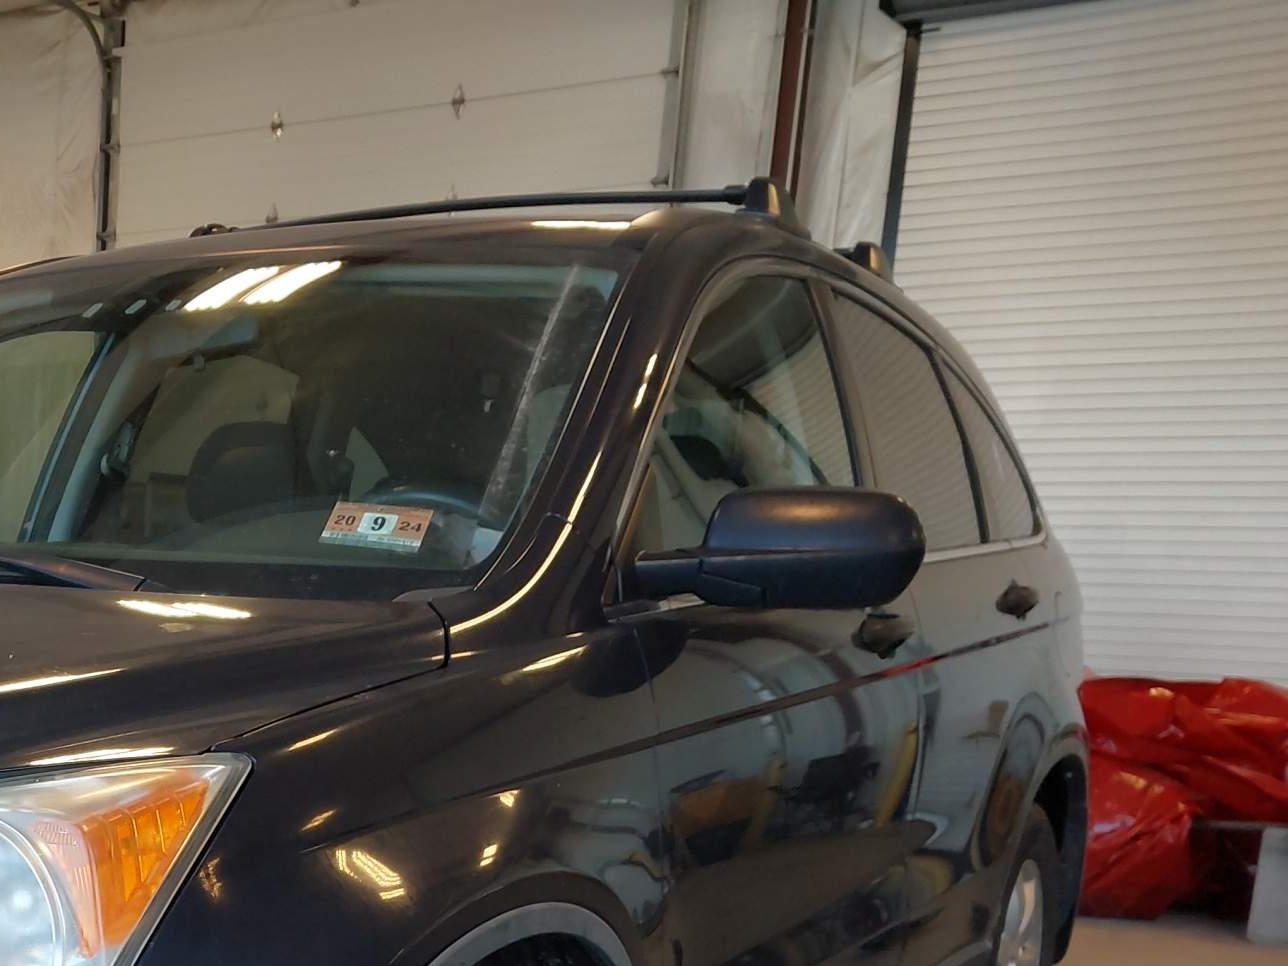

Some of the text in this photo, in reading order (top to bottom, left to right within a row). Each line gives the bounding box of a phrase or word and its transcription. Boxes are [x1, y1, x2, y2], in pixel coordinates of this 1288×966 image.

[334, 514, 422, 533] 20 9 24
